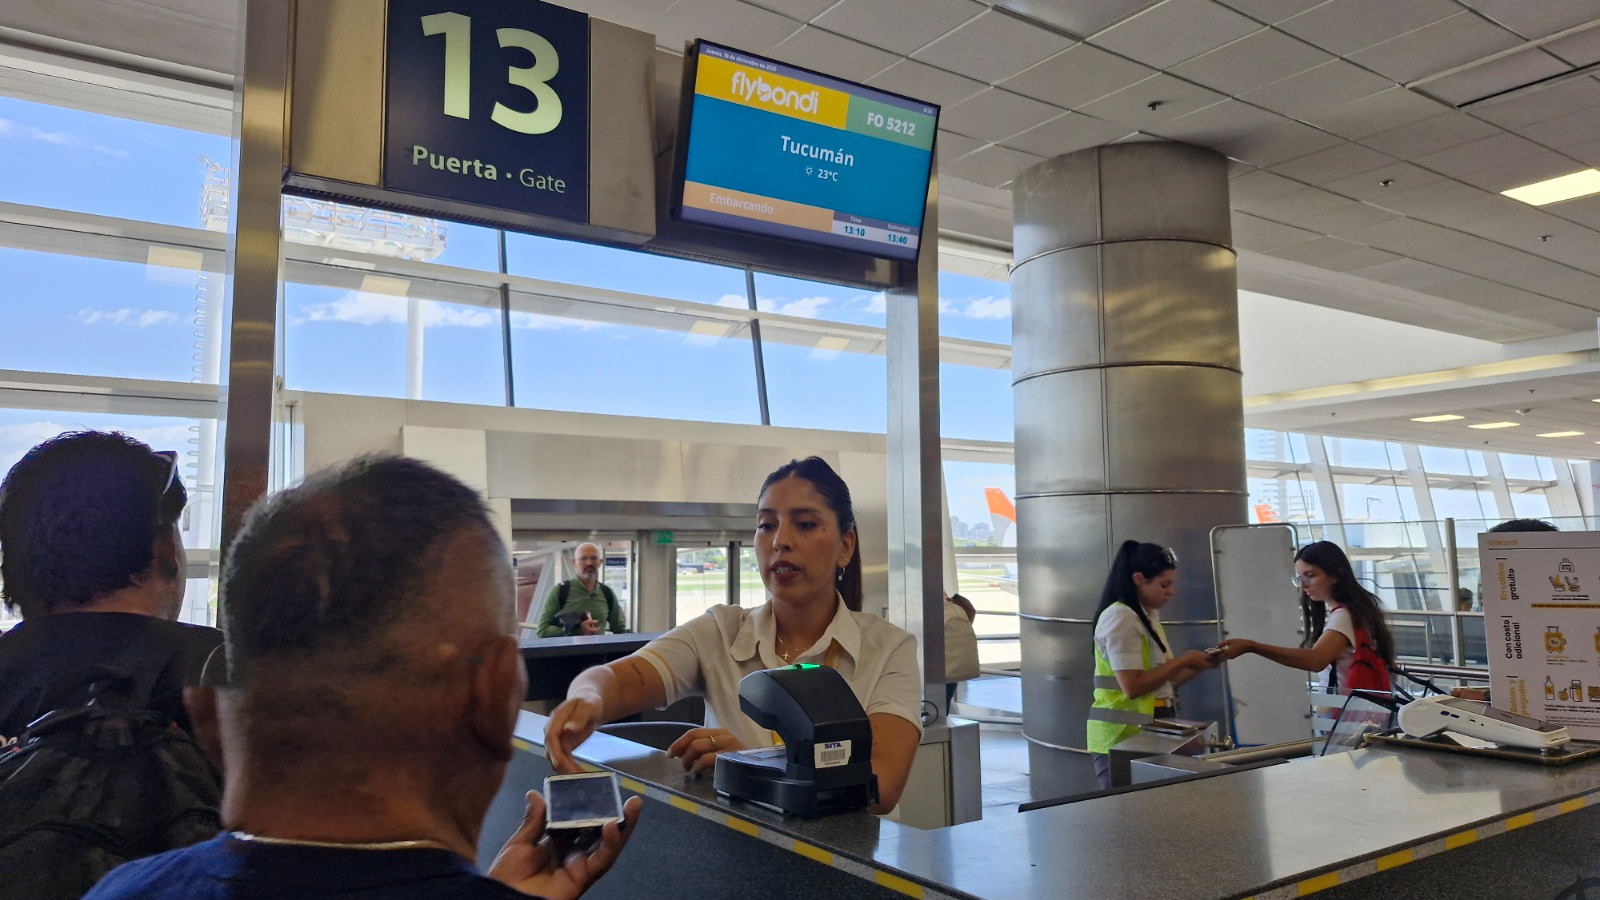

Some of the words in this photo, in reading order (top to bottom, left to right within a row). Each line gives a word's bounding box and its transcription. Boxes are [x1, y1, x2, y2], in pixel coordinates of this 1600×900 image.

[421, 12, 563, 135] 13
[736, 56, 758, 67] diciembre
[731, 71, 819, 115] flybondi
[867, 112, 884, 128] FO
[886, 115, 915, 136] 5212
[781, 135, 854, 167] Tucumán
[412, 144, 498, 181] Puerta
[519, 168, 566, 193] Gate
[710, 193, 774, 214] Embarcando
[844, 225, 866, 237] 13:10
[888, 233, 908, 245] 13:40
[1507, 568, 1519, 601] gratuito
[1503, 619, 1511, 642] costo
[1512, 622, 1523, 659] adicional
[1505, 642, 1513, 659] Con
